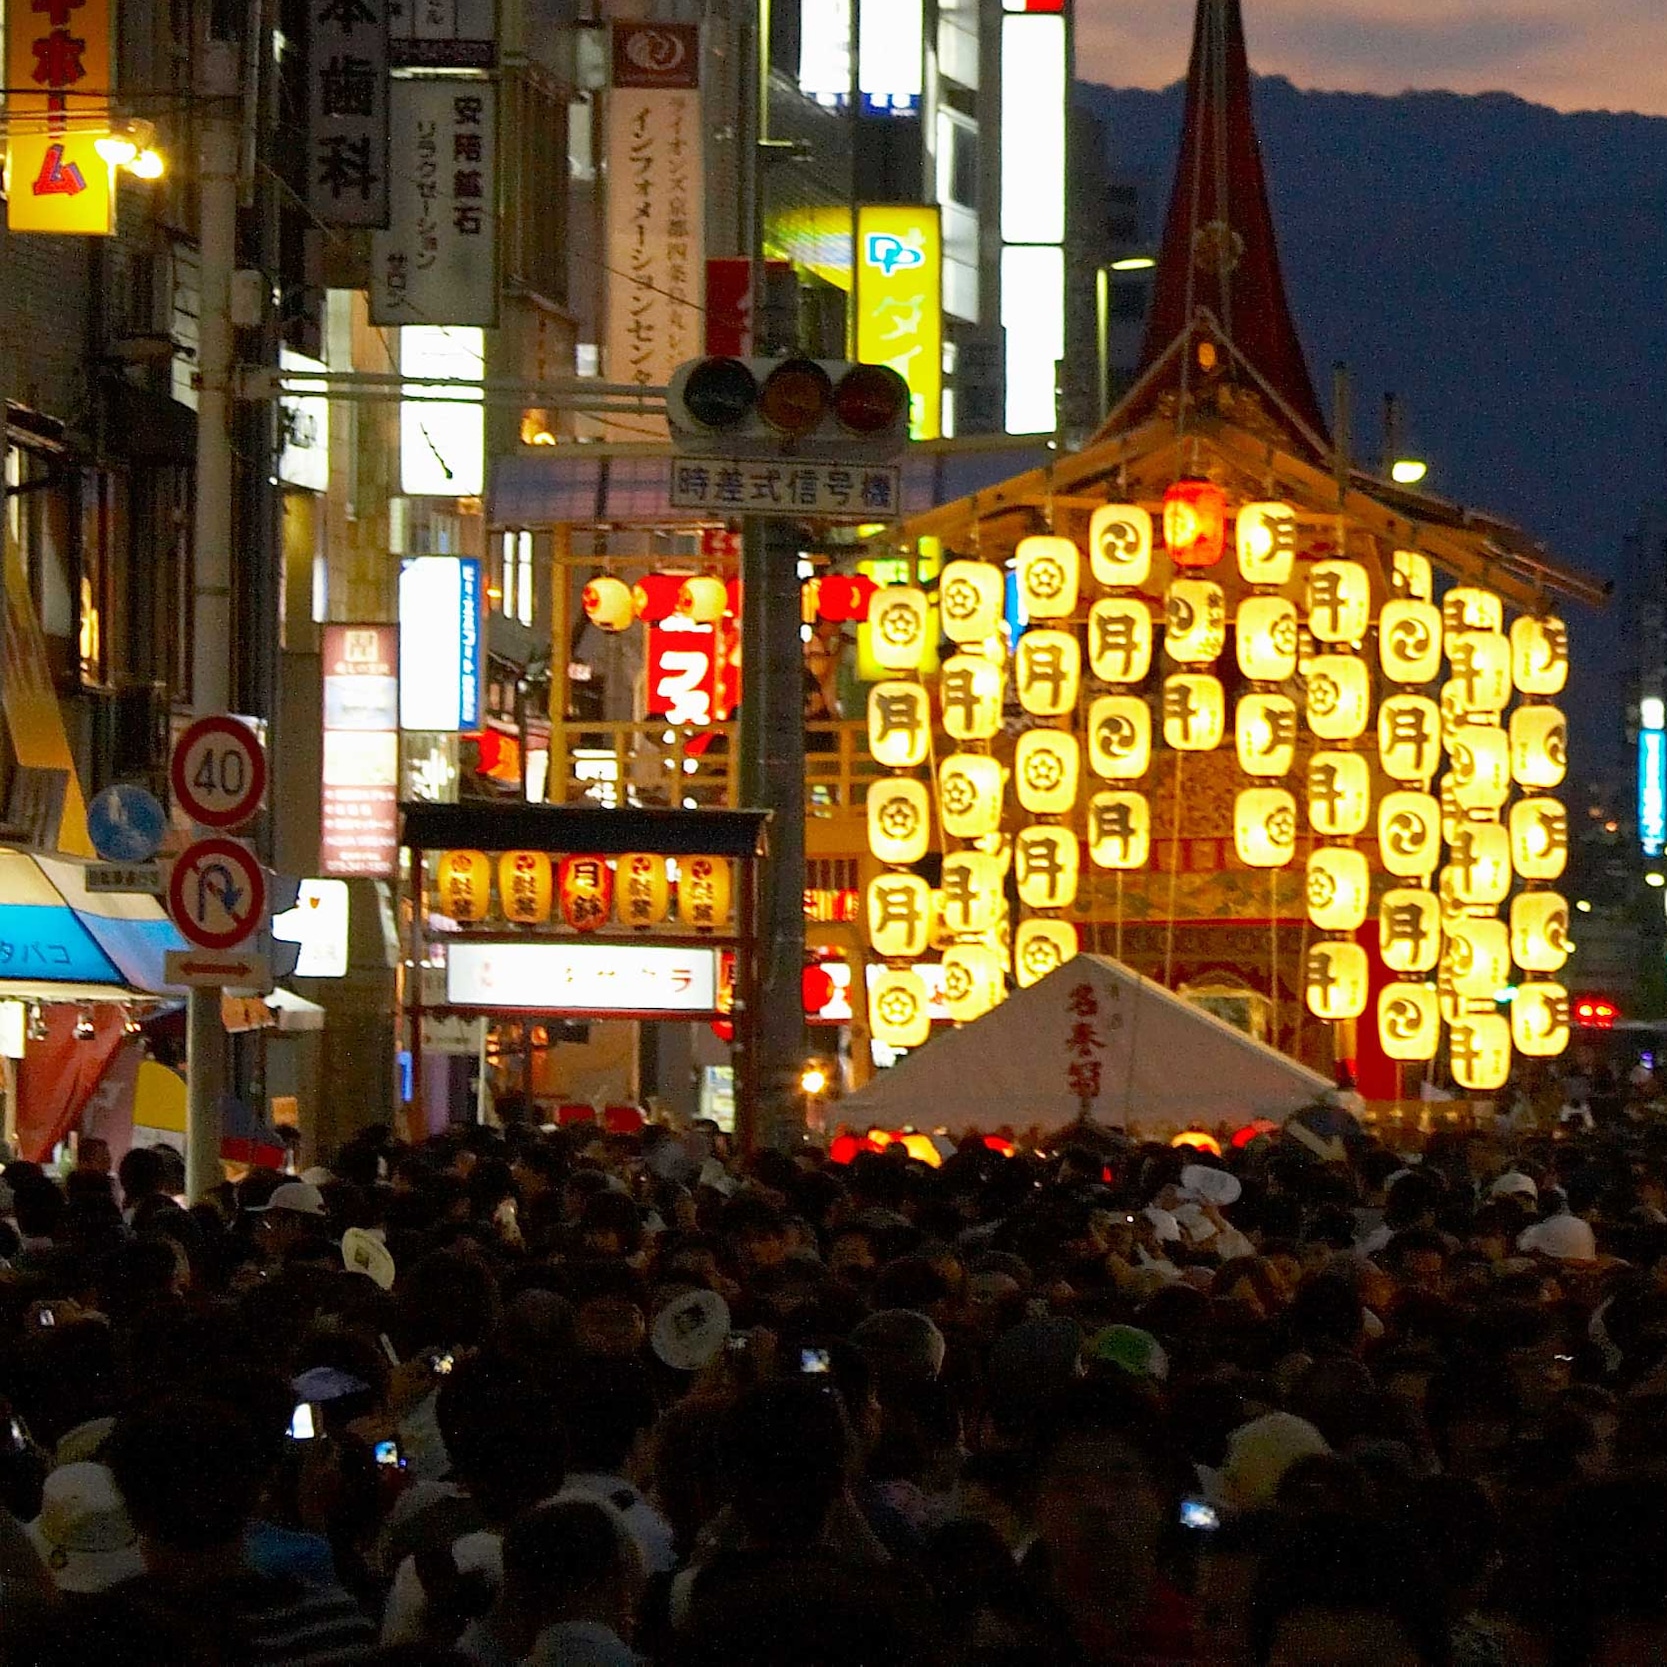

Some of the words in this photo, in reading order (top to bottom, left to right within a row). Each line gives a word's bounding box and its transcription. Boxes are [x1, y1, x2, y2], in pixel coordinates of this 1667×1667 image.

[675, 459, 893, 514] 時差式信号機
[1311, 571, 1350, 634] 月
[1024, 644, 1068, 709] 月
[1096, 613, 1138, 677] 月
[1451, 641, 1483, 706] 月
[877, 692, 922, 760] 月
[944, 668, 981, 733] 月
[1165, 684, 1198, 742] 月
[1385, 705, 1431, 772] 月
[193, 747, 246, 797] 40
[1308, 764, 1346, 828] 月
[1092, 801, 1137, 864] 月
[1450, 830, 1479, 895] 月
[945, 865, 980, 927] 月
[1020, 837, 1063, 902] 月
[876, 885, 922, 949] 月
[1383, 902, 1428, 965] 月
[1308, 951, 1341, 1012] 月
[1450, 1024, 1483, 1083] 月
